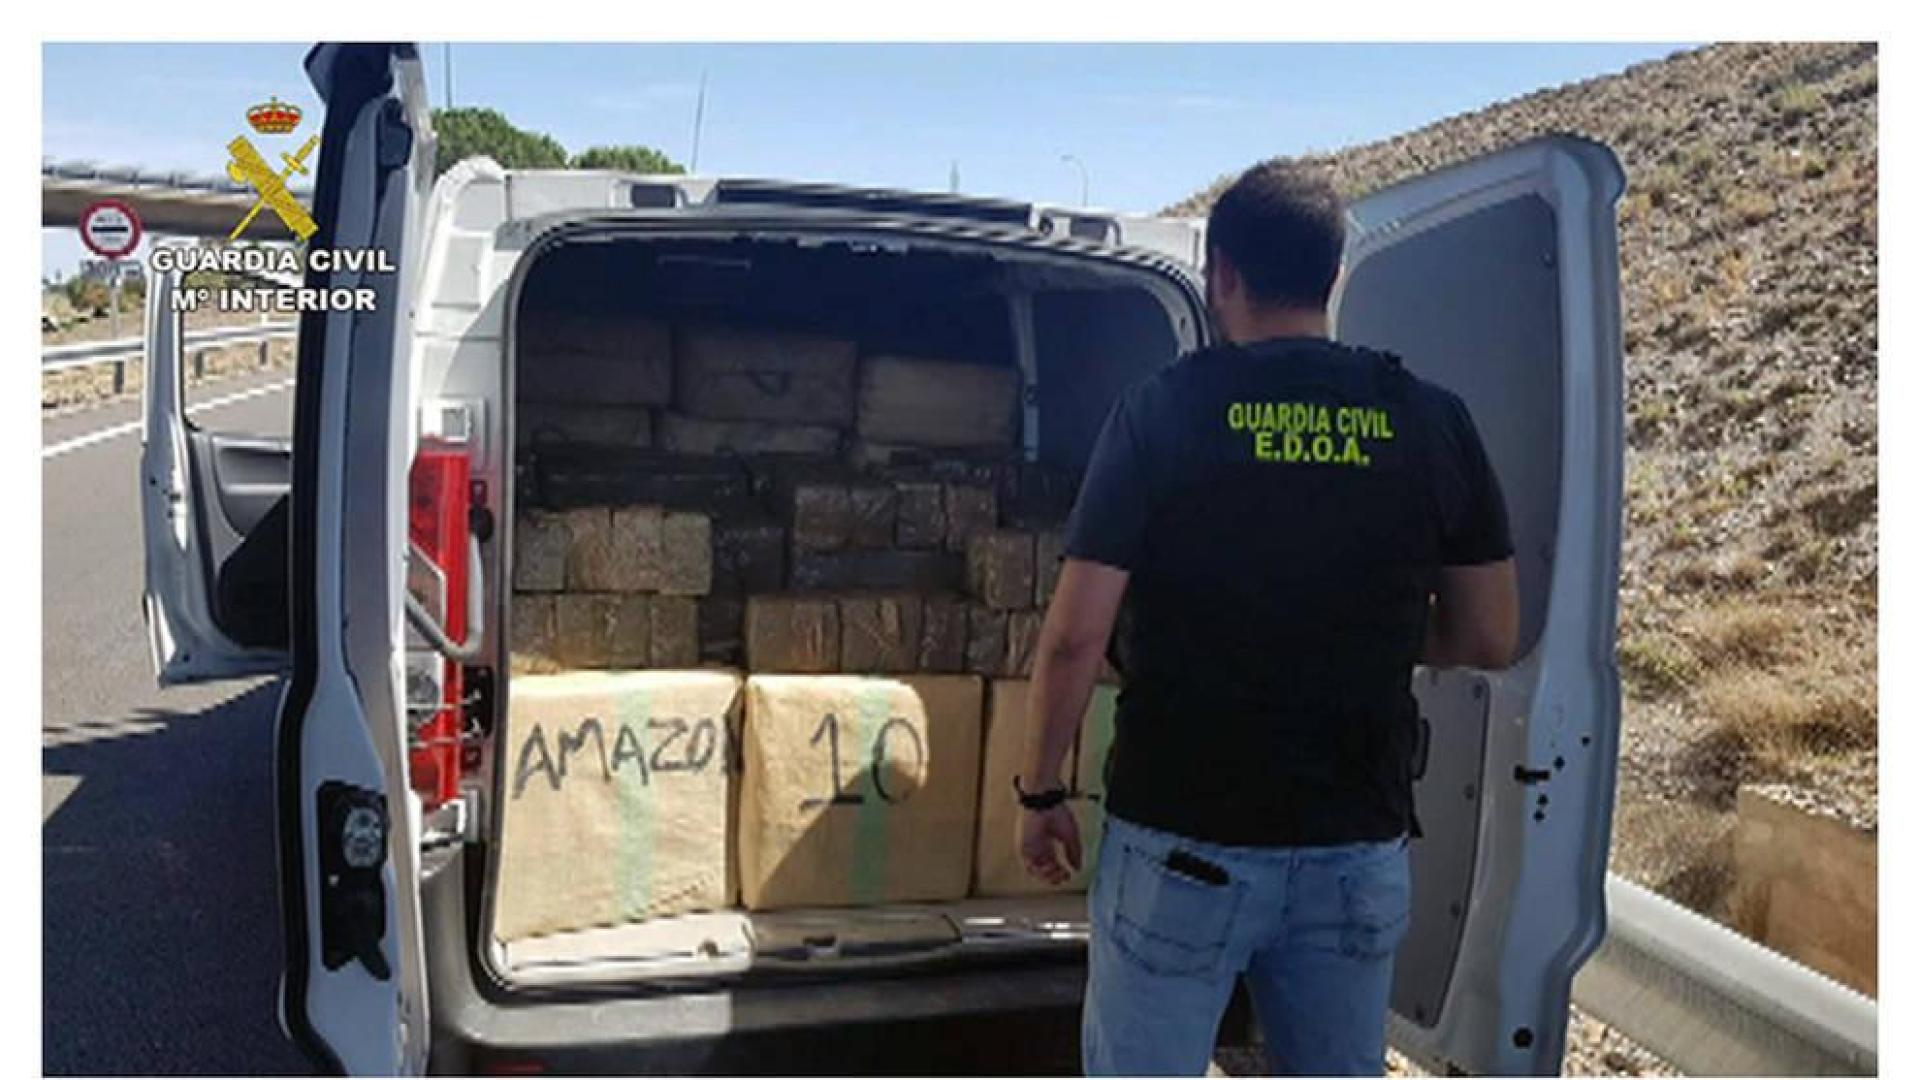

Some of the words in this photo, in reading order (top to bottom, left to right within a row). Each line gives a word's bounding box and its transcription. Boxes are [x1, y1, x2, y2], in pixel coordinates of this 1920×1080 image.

[1228, 403, 1332, 433] GUARDIA
[1337, 407, 1394, 438] CIVIL
[1256, 432, 1371, 466] E.D.O.A.
[799, 712, 929, 808] 10
